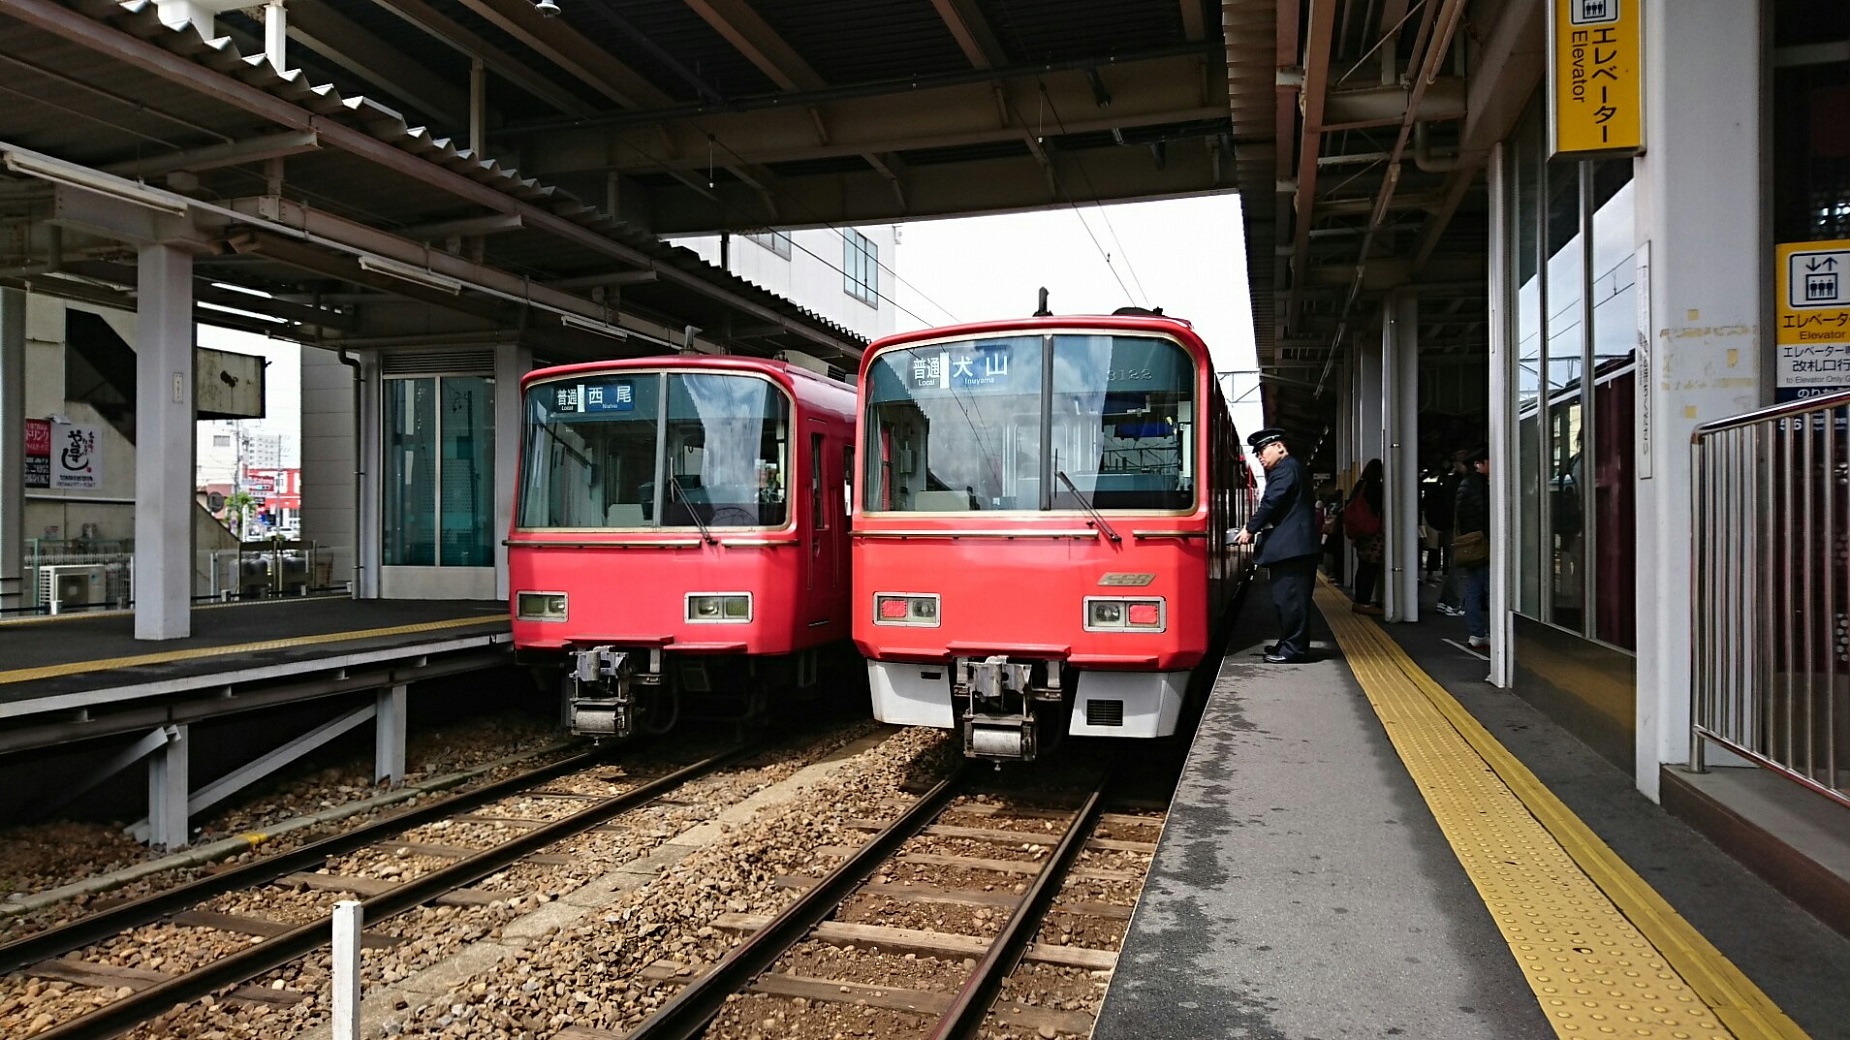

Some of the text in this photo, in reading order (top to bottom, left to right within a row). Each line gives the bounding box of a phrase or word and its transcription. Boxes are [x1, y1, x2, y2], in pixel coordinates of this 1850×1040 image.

[1572, 30, 1588, 103] Elevator
[1592, 27, 1618, 143] エレベーター
[1783, 312, 1850, 328] エレベータ
[1800, 331, 1846, 340] Elevator
[913, 357, 941, 380] 普通
[953, 353, 1008, 379] 犬山
[918, 379, 935, 387] Local
[964, 377, 995, 385] Inuyama
[1795, 376, 1825, 384] Elevator
[1826, 375, 1843, 384] Only
[557, 388, 578, 406] 普通
[588, 385, 632, 405] 西尾
